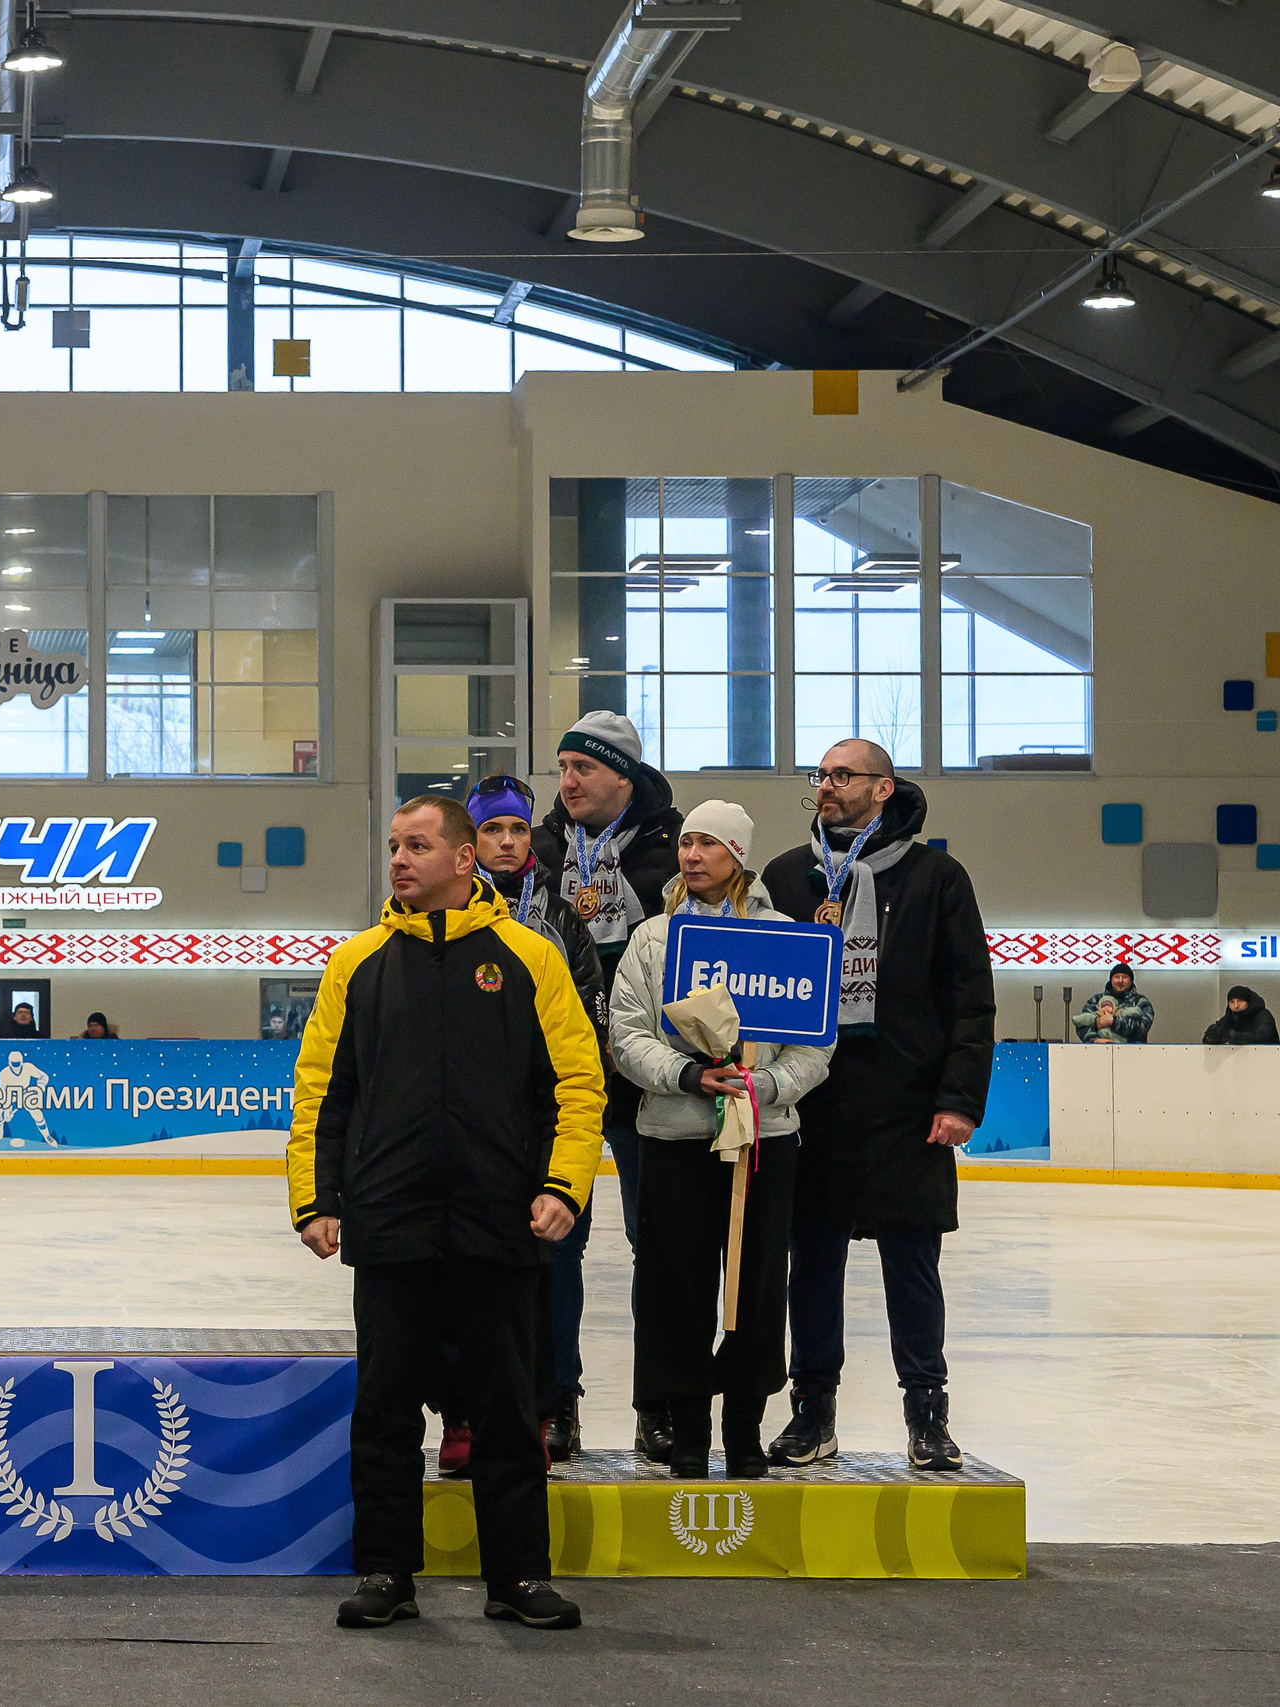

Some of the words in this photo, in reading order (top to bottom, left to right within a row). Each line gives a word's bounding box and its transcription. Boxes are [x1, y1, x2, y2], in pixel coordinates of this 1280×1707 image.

[584, 739, 629, 770] БЕЛАРУСЬ
[87, 891, 157, 907] ЦЕНТР
[690, 959, 813, 1001] Единые
[842, 957, 878, 977] ЕДИ
[683, 1493, 740, 1531] III
